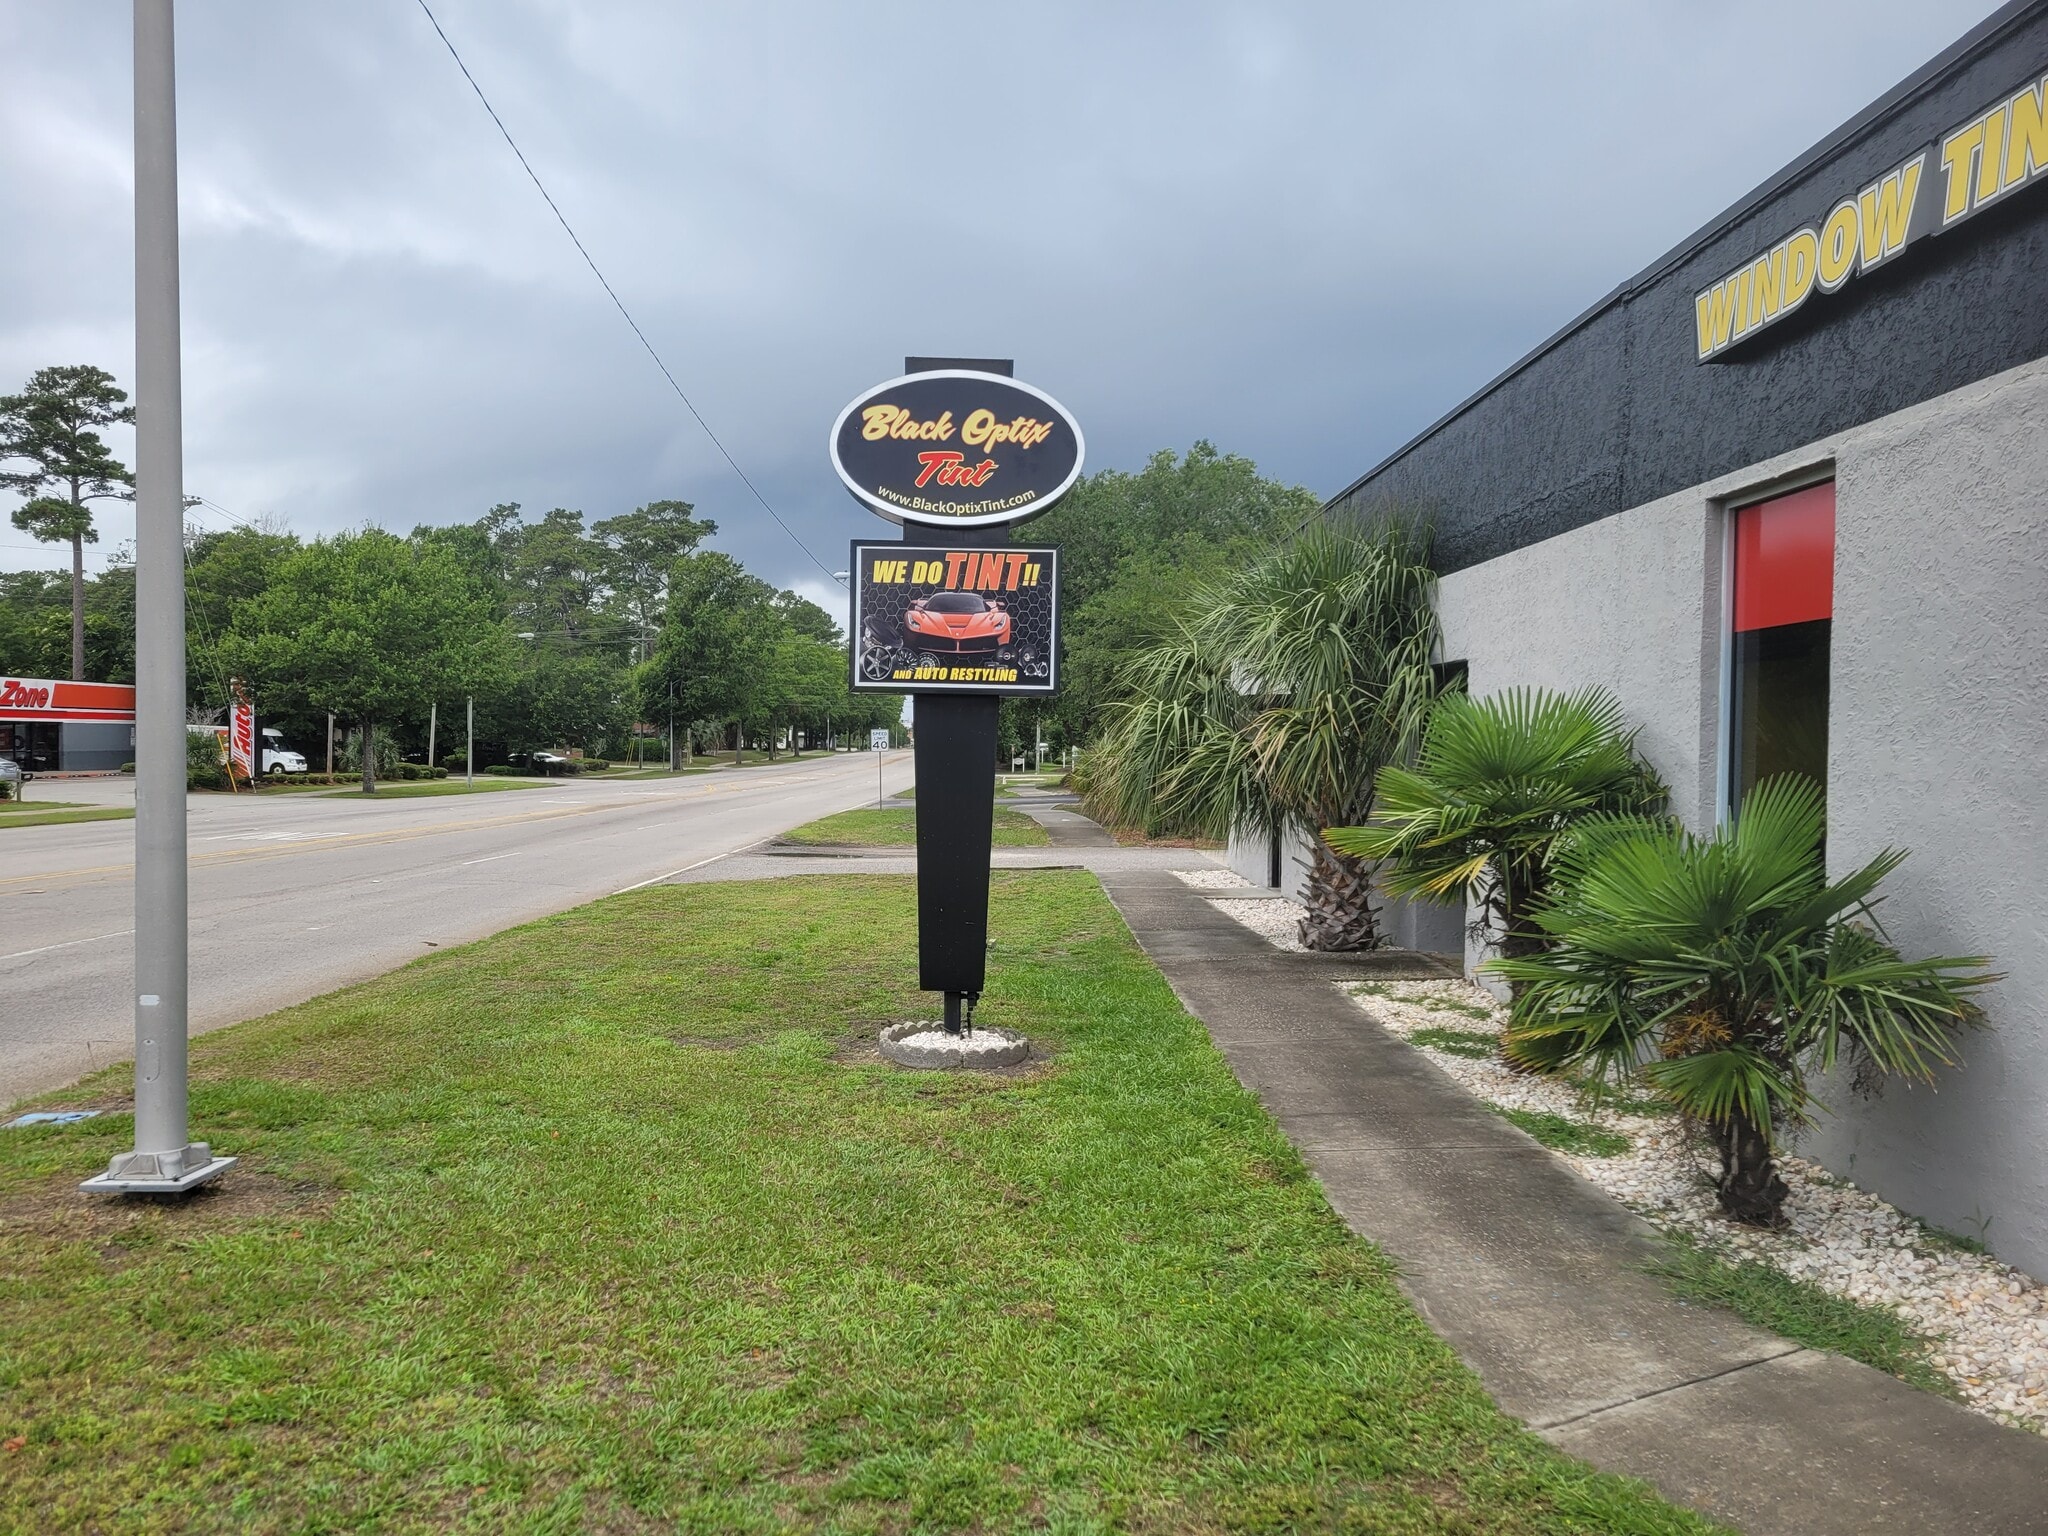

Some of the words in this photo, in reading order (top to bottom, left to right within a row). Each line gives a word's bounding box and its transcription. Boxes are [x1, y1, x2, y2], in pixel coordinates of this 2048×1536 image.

[1696, 153, 1926, 360] WINDOW
[1941, 74, 2048, 226] TIN
[862, 404, 956, 441] Black
[961, 408, 1054, 454] Optix
[915, 451, 999, 488] Tint
[878, 486, 1036, 516] www.BlackOptixTint.com
[873, 560, 908, 583] WE
[911, 561, 943, 584] DO
[892, 670, 912, 680] AND
[914, 667, 948, 680] AUTO
[950, 668, 1018, 682] RESTYLING
[0, 680, 49, 708] Zone
[233, 690, 252, 757] Auto
[872, 741, 887, 749] 40
